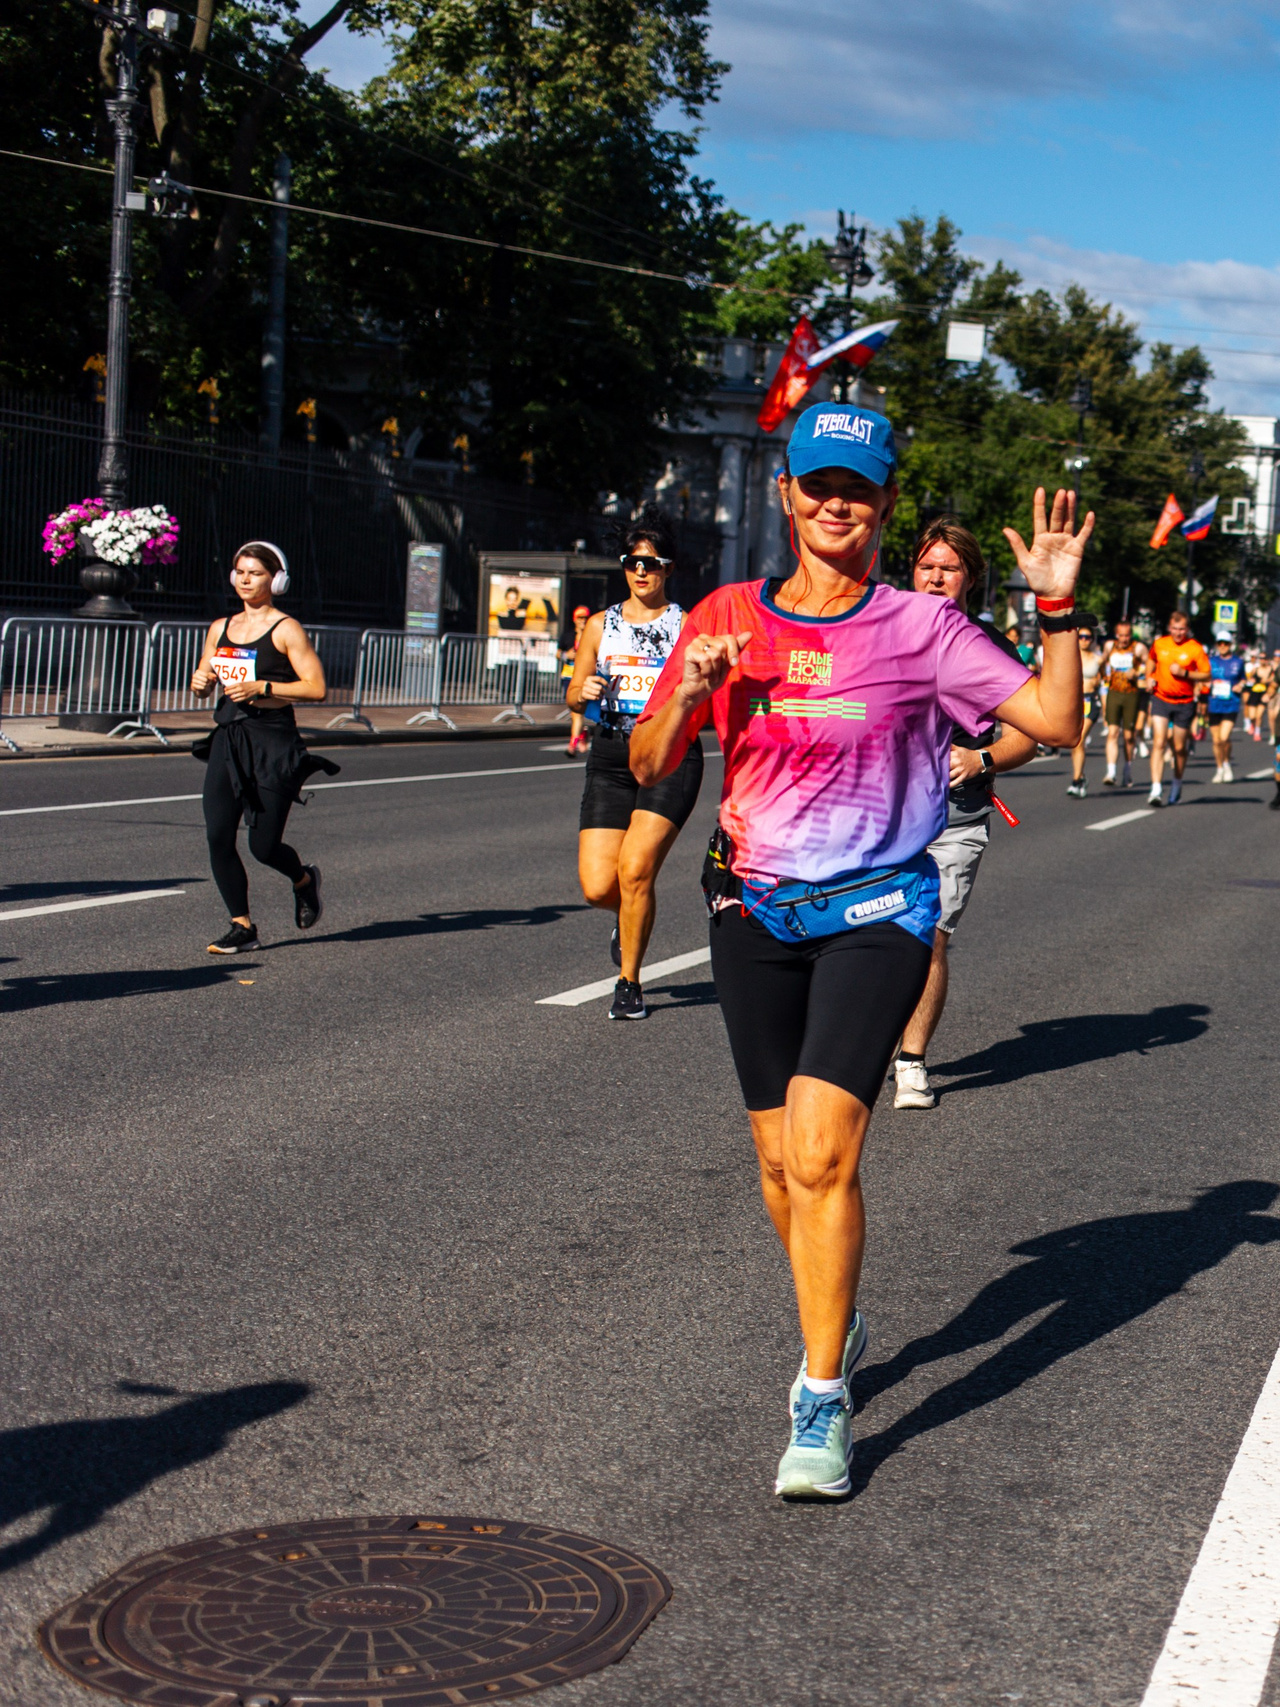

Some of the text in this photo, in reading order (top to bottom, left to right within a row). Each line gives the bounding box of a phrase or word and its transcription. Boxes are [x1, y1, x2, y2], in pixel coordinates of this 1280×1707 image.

[812, 413, 875, 445] EVERLAST
[830, 432, 855, 442] BOXING
[790, 650, 834, 667] БЕЛЫЕ
[214, 664, 248, 682] 7549
[788, 663, 832, 678] НОЧИ
[610, 674, 656, 693] 7339
[786, 675, 831, 687] МАРАФОН
[853, 888, 906, 918] RUNZONE
